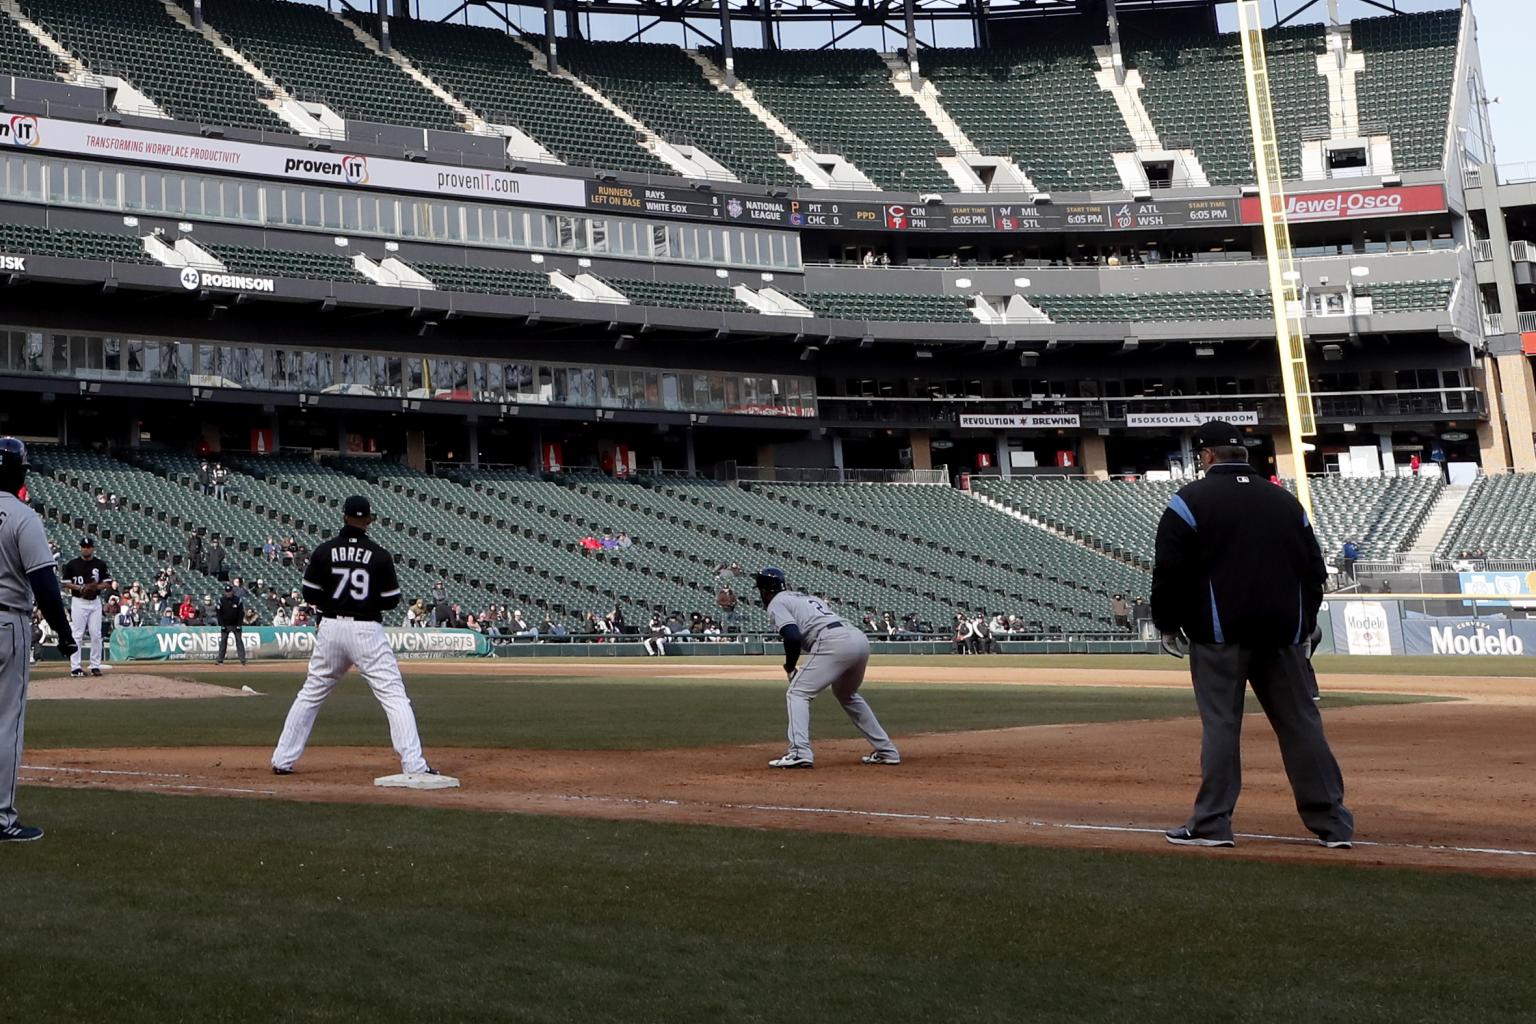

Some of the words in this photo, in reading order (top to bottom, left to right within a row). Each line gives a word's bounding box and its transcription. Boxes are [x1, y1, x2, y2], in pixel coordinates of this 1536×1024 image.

[18, 124, 33, 139] IT
[86, 135, 143, 153] TRANSFORMING
[145, 142, 189, 158] WORKPLACE
[189, 148, 241, 164] PRODUCTIVITY
[285, 156, 342, 176] proven
[349, 162, 362, 177] IT
[438, 172, 520, 194] provenIT.com
[598, 186, 633, 198] RUNNERS
[645, 190, 665, 200] RAYS
[713, 196, 718, 204] 8
[591, 194, 607, 205] LEFT
[609, 196, 620, 206] ON
[622, 197, 641, 208] BASE
[746, 201, 784, 212] NATIONAL
[1286, 193, 1402, 214] Jewel-Osco
[646, 201, 669, 213] WHITE
[670, 204, 687, 214] SOX
[713, 208, 718, 217] 8
[808, 204, 822, 214] PIT
[832, 205, 838, 214] 0
[910, 207, 925, 216] CIN
[1021, 208, 1040, 217] MIL
[1139, 204, 1159, 214] ATL
[751, 210, 781, 221] LEAGUE
[807, 215, 826, 225] CHC
[833, 216, 839, 225] 0
[857, 211, 876, 220] PPD
[953, 216, 971, 225] 6:05
[972, 216, 987, 225] PM
[1067, 215, 1086, 224] 6:05
[1088, 214, 1103, 223] PM
[1190, 211, 1209, 220] 6:05
[1211, 210, 1227, 219] PM
[911, 219, 927, 228] PHI
[1023, 219, 1039, 228] STL
[1137, 216, 1163, 226] WSH
[182, 272, 198, 284] 42
[201, 273, 274, 292] ROBINSON
[962, 417, 1015, 425] REVOLUTION
[1032, 417, 1077, 425] BREWING
[1131, 416, 1191, 424] #SOXSOCIAL
[331, 546, 372, 564] ABREU
[73, 575, 84, 585] 70
[331, 567, 370, 600] 79
[808, 599, 833, 616] 2
[1348, 616, 1385, 630] Modelo
[1455, 620, 1491, 631] CERVEZA
[156, 632, 206, 652] WGN
[210, 635, 258, 647] SOTS
[385, 632, 428, 651] WGN
[430, 636, 473, 647] SPORTS
[1430, 626, 1524, 656] Modelo
